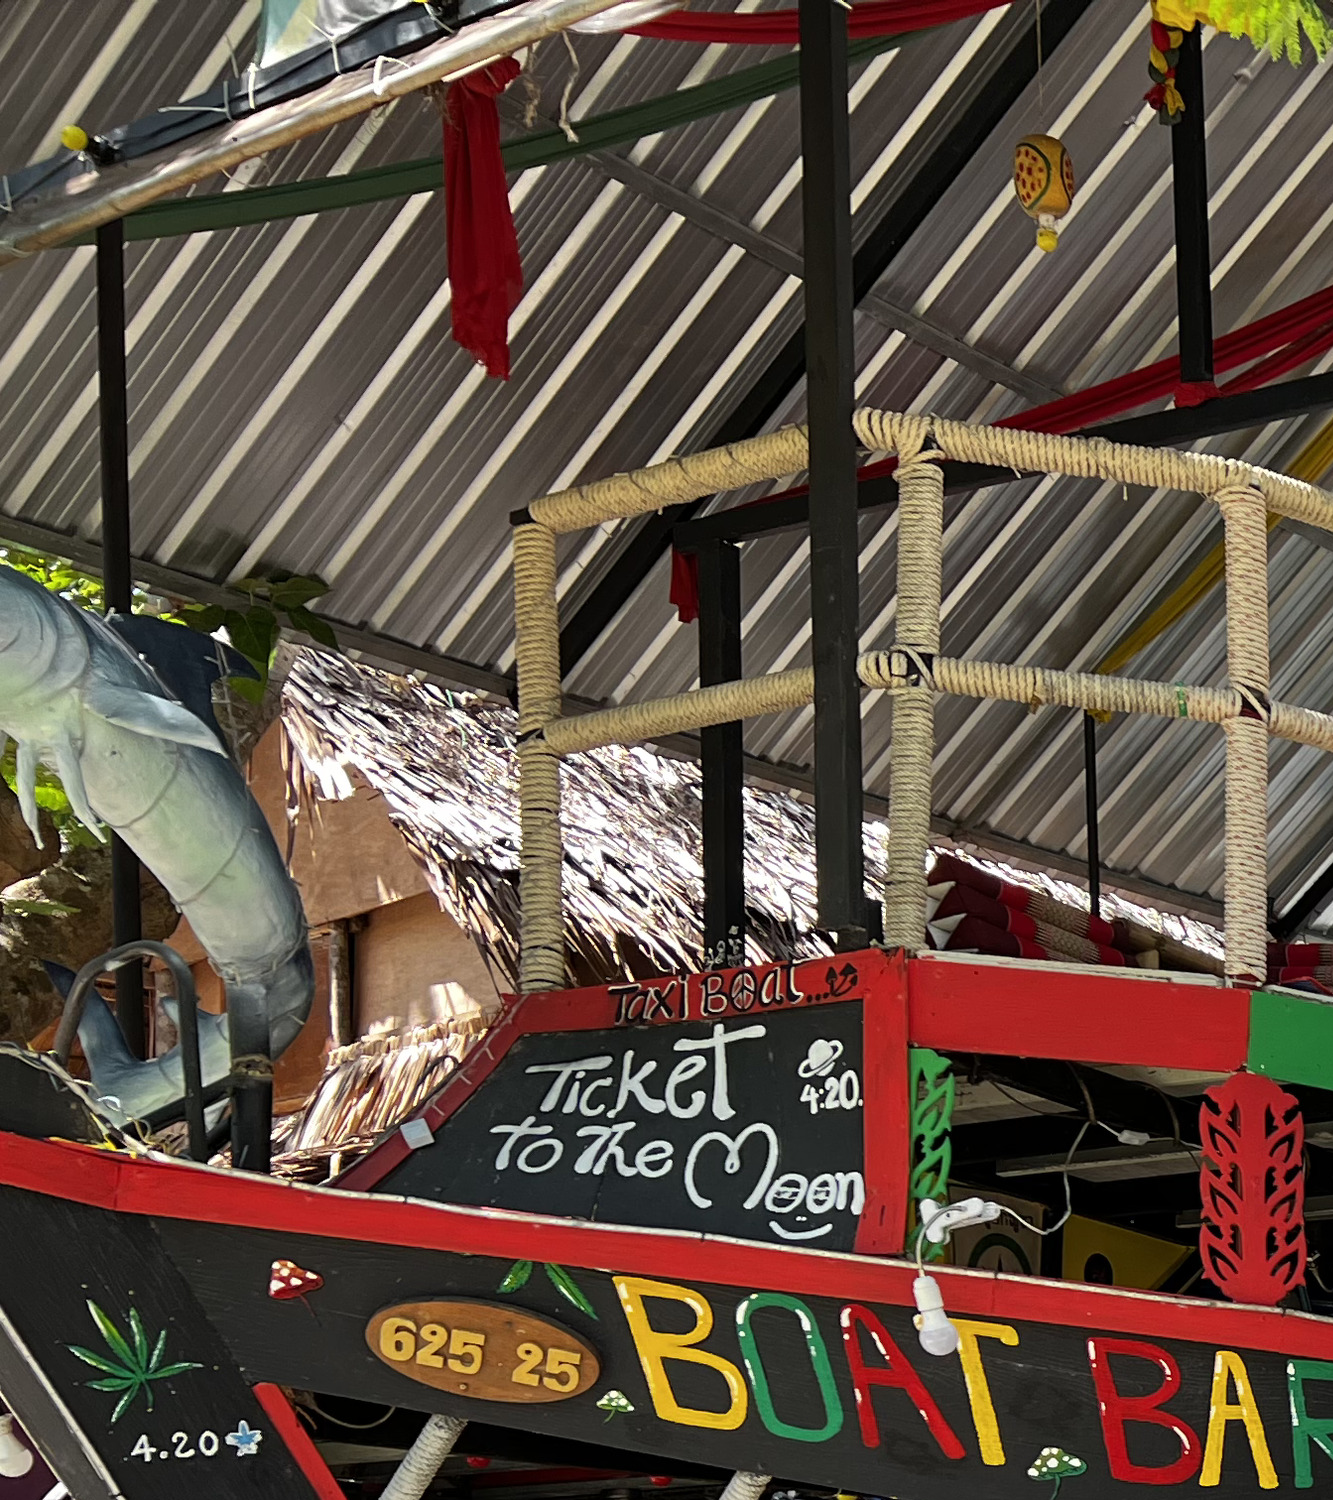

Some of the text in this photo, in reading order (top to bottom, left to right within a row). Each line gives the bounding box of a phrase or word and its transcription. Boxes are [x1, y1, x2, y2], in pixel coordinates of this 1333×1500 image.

[490, 1116, 564, 1173] to
[685, 1122, 865, 1215] Moon
[379, 1318, 582, 1392] 625 25
[612, 1276, 1020, 1466] BOAT
